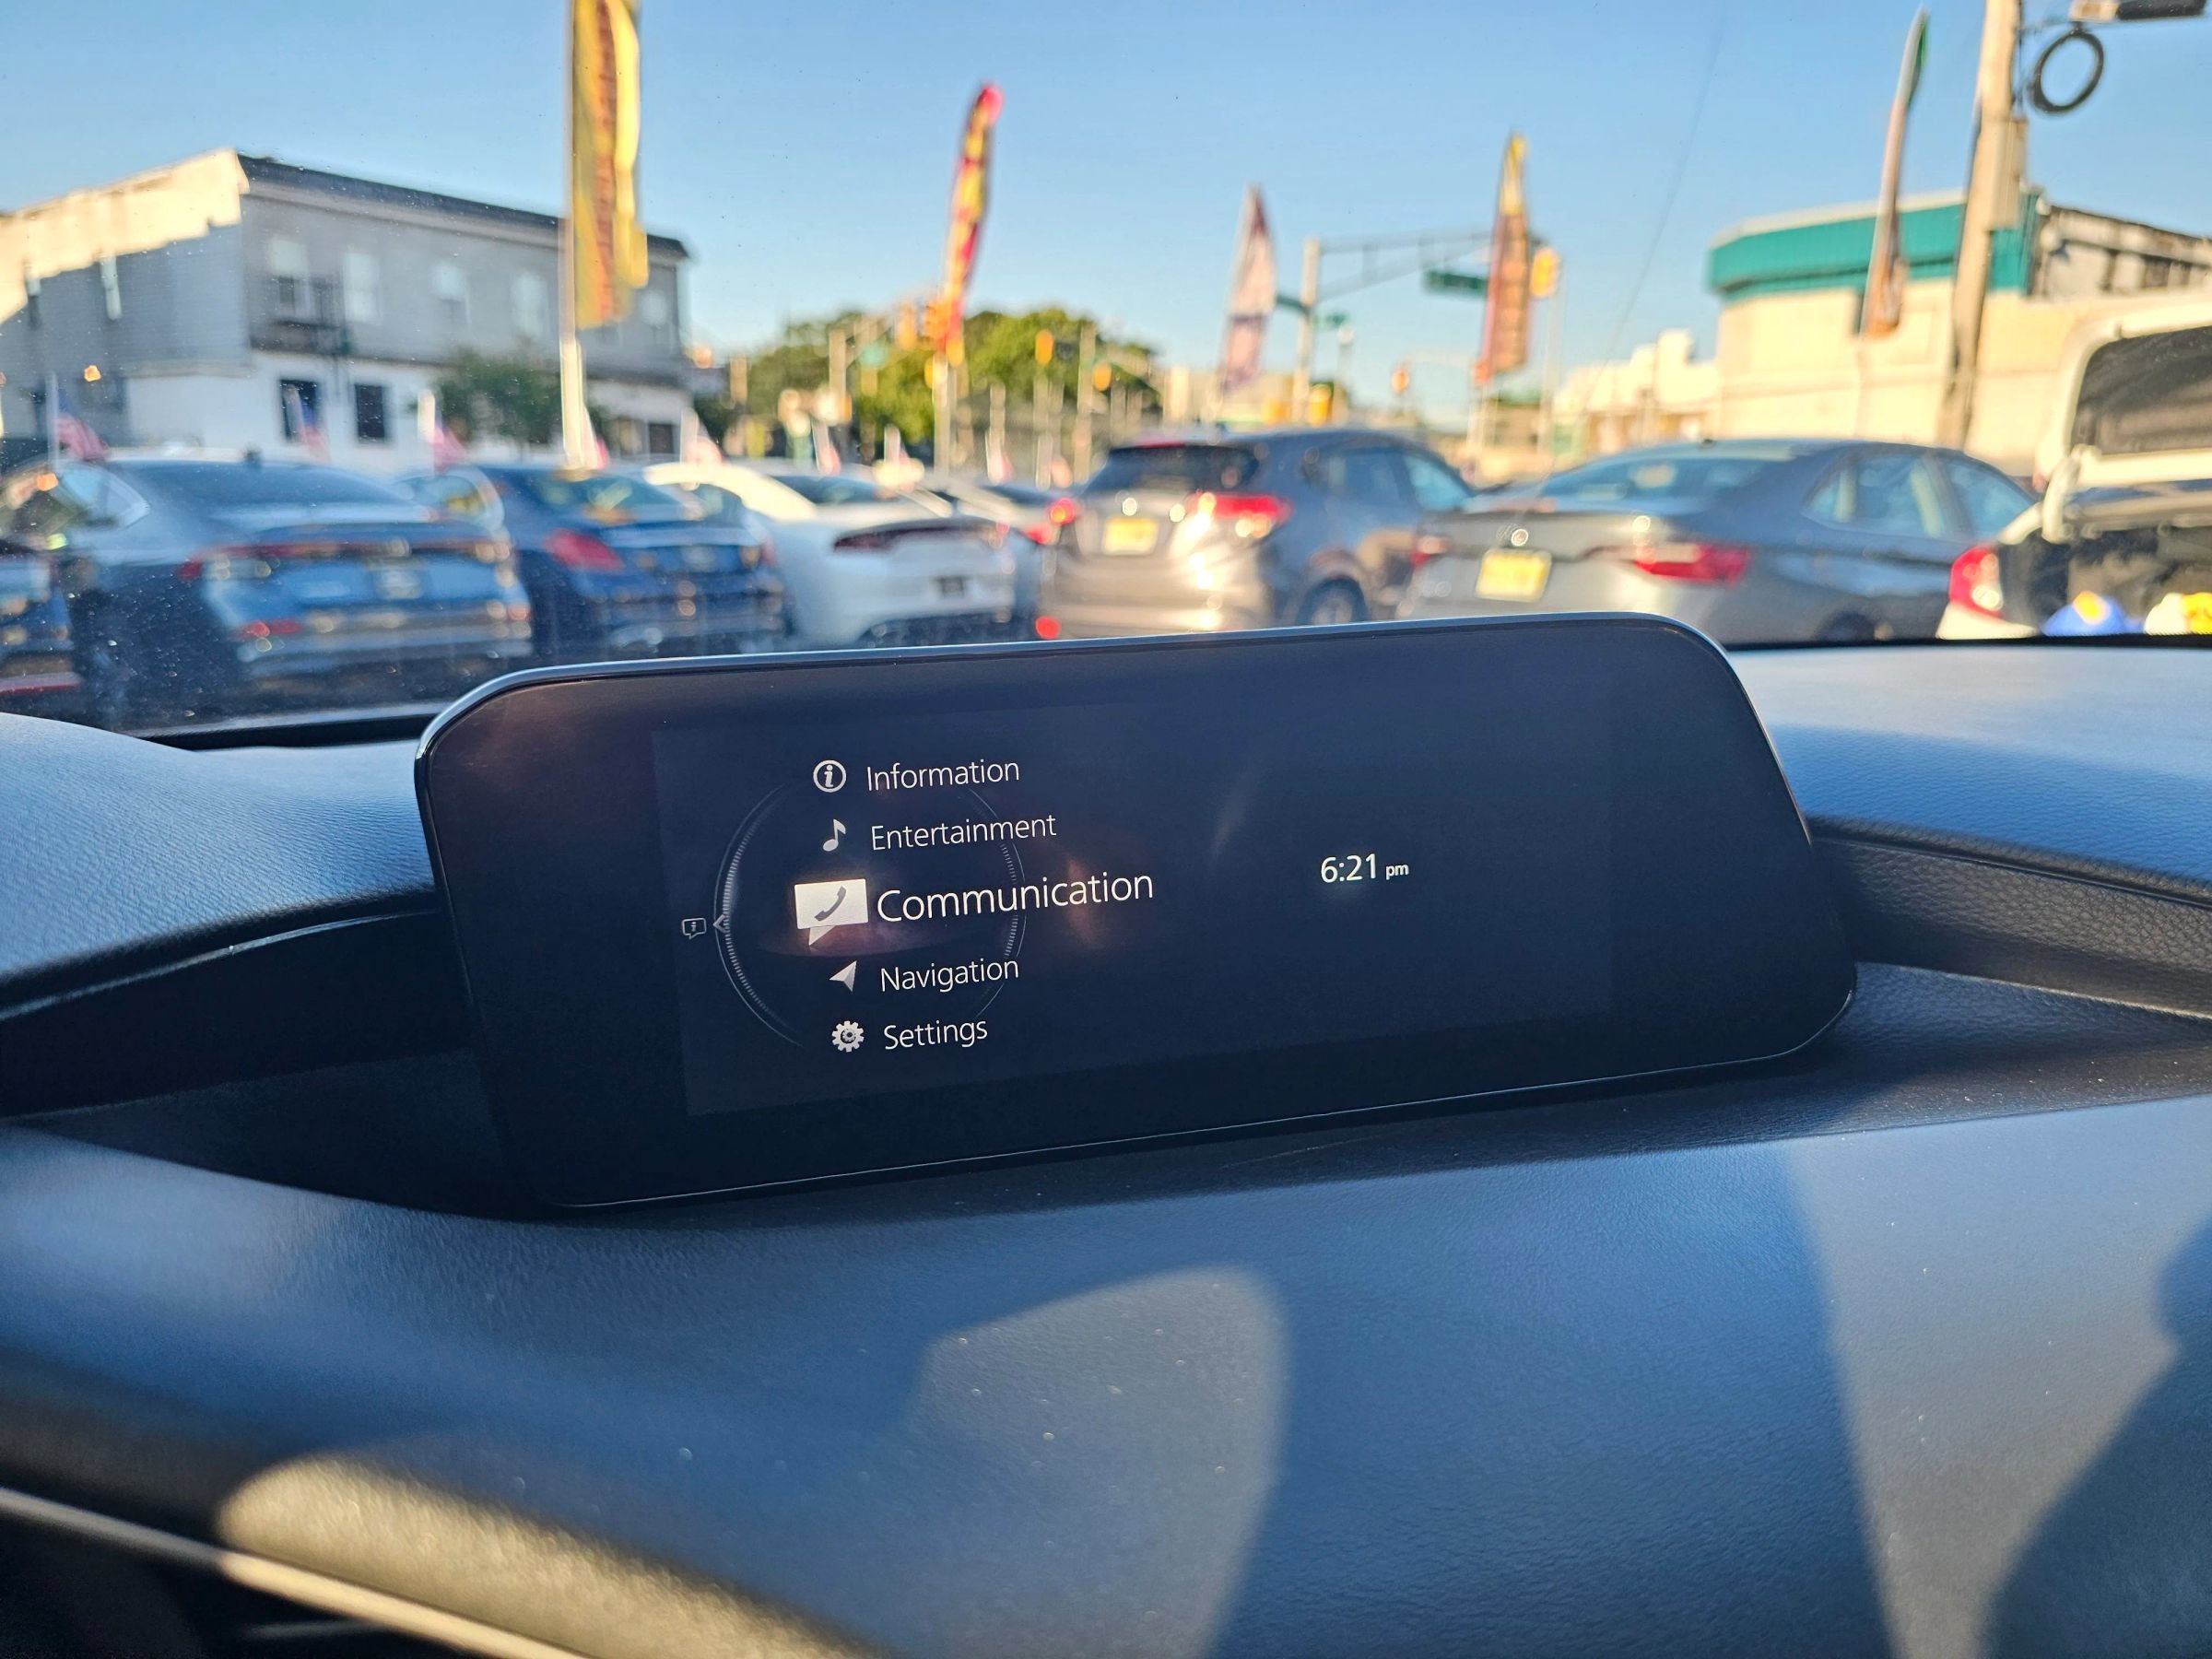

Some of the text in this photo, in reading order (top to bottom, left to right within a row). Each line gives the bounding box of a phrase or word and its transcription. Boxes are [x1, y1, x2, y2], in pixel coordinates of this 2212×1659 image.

[866, 759, 1020, 792] Information
[871, 814, 1057, 851] Entertainment
[1321, 853, 1410, 884] 6:21 pm
[877, 871, 1154, 923] Communication
[880, 957, 1019, 993] Navigation
[883, 1018, 989, 1051] Settings
